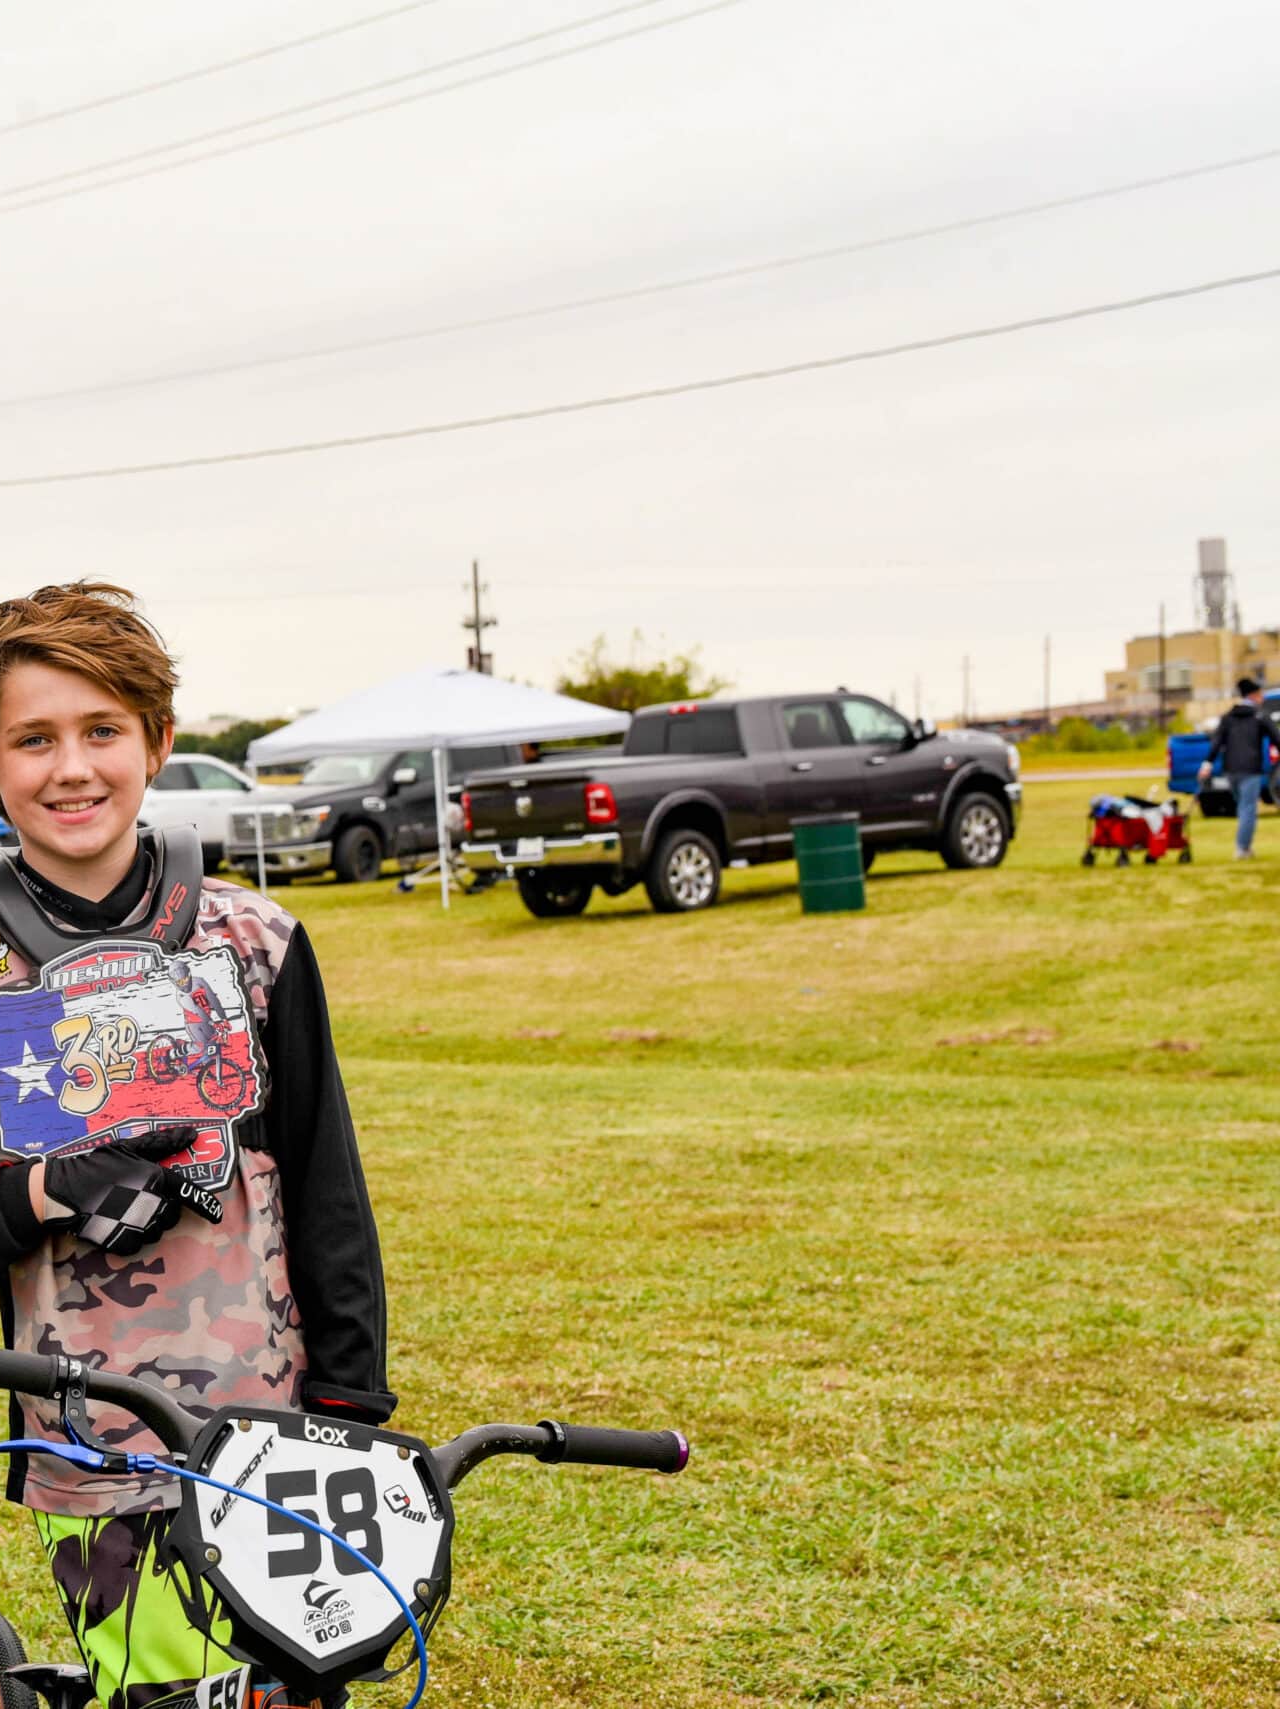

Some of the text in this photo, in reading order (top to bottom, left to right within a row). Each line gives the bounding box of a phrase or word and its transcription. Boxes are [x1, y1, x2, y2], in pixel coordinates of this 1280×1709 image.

[52, 954, 153, 989] DESOTO
[63, 971, 145, 998] BMX
[53, 1013, 138, 1115] 3RD
[304, 1417, 349, 1447] box
[265, 1467, 383, 1578] 58
[209, 1668, 242, 1709] 58
